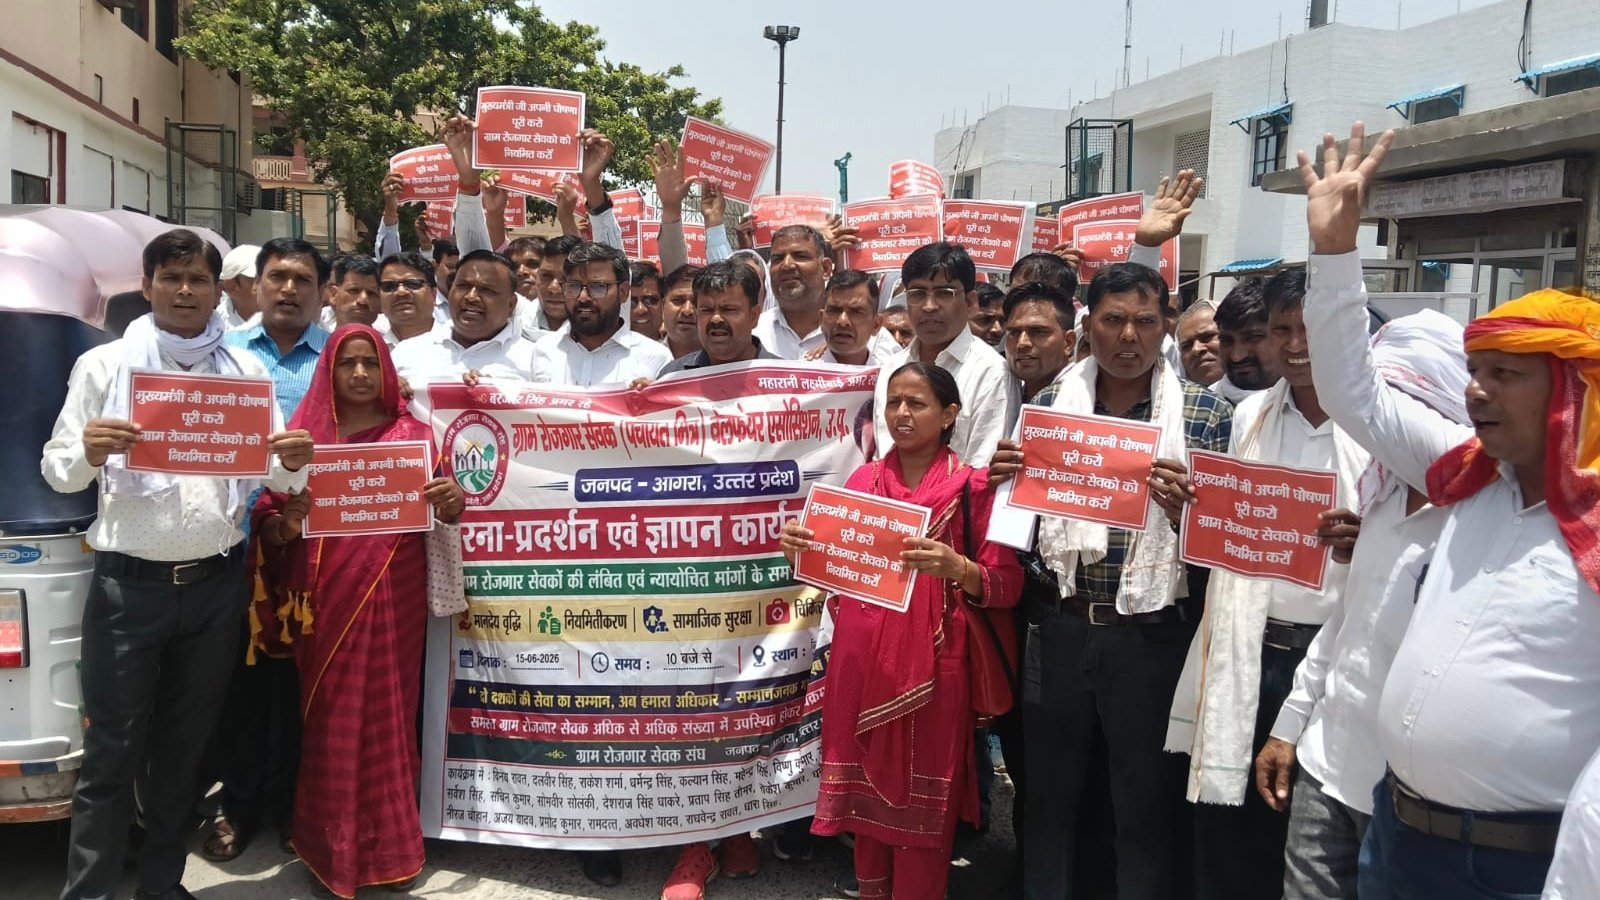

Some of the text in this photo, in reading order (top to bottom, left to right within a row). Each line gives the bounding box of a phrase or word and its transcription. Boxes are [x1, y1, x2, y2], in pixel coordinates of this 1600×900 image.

[481, 99, 577, 115] मुख्यमंत्री जी अपनी घोषणा
[512, 116, 543, 129] पूरी करो
[484, 131, 571, 144] ग्राम रोजगार सेवको को
[504, 147, 534, 158] नियमित
[758, 374, 798, 388] महारानी
[135, 389, 268, 407] मुख्यमंत्री जी अपनी घोषणा
[182, 410, 224, 426] पूरी करो
[168, 429, 261, 445] रोजगार सेवको को
[511, 423, 538, 458] ग्राम
[537, 414, 585, 452] रोजगार
[581, 413, 618, 450] सेवक
[1024, 426, 1152, 453] मुख्यमंत्री जी अपनी घोषणा
[168, 448, 237, 463] नियमित करों
[352, 457, 423, 470] जी अपनी घोषणा
[1063, 450, 1103, 467] पूरी करो
[349, 475, 385, 491] पूरी करो
[581, 466, 795, 494] जनपद आगरा, उत्तर प्रदेश
[1026, 466, 1139, 493] ग्राम रोजगार सेवको को
[1194, 470, 1331, 505] मुख्यमंत्री जी अपनी घोषणा
[315, 491, 419, 507] ग्राम रोजगार सेवको को
[1047, 487, 1112, 510] नियमित करों
[341, 510, 377, 523] नियमित
[811, 502, 917, 537] मुख्यमंत्री जी अपनी घोषणा
[1235, 502, 1277, 519] पूरी करो
[606, 514, 723, 554] एवं ज्ञापन
[841, 528, 874, 546] पूरी करो
[1198, 515, 1298, 544] ग्राम रोजगार सेवको
[828, 545, 887, 570] रोजगार सेवको
[1224, 540, 1292, 565] नियमित करों
[481, 563, 763, 590] रोजगार सेवकों की लंबित एवं न्यायोचित मांगों के
[826, 562, 881, 587] नियमित करों
[473, 609, 521, 635] मानदेय वृद्धि
[564, 608, 627, 630] नियमितीकरण
[672, 607, 752, 632] सामाजिक सुरक्षा
[516, 653, 560, 664] 15-06-2026
[614, 647, 713, 671] समय 10 बजे से
[771, 646, 798, 663] स्थान
[491, 685, 798, 710] दशकों की सेवा का सम्मान, अब हमारा अधिकार सम्मानजनक
[470, 712, 776, 735] समस्त ग्राम रोजगार सेवक अधिक से अधिक संख्या में उपस्थित
[575, 745, 706, 764] ग्राम रोजगार सेवक संघ
[447, 764, 732, 790] कार्यक्रम दलवीर राकेश शर्मा, सिंह, कल्यान सिंह,
[512, 789, 731, 810] कुमार, देशराज सिंह प्रताप सिंह
[446, 803, 465, 821] नीरज
[539, 813, 557, 830] प्रमोद
[560, 819, 585, 834] कुमार,
[625, 814, 654, 829] अवधेश
[656, 816, 682, 827] यादव,
